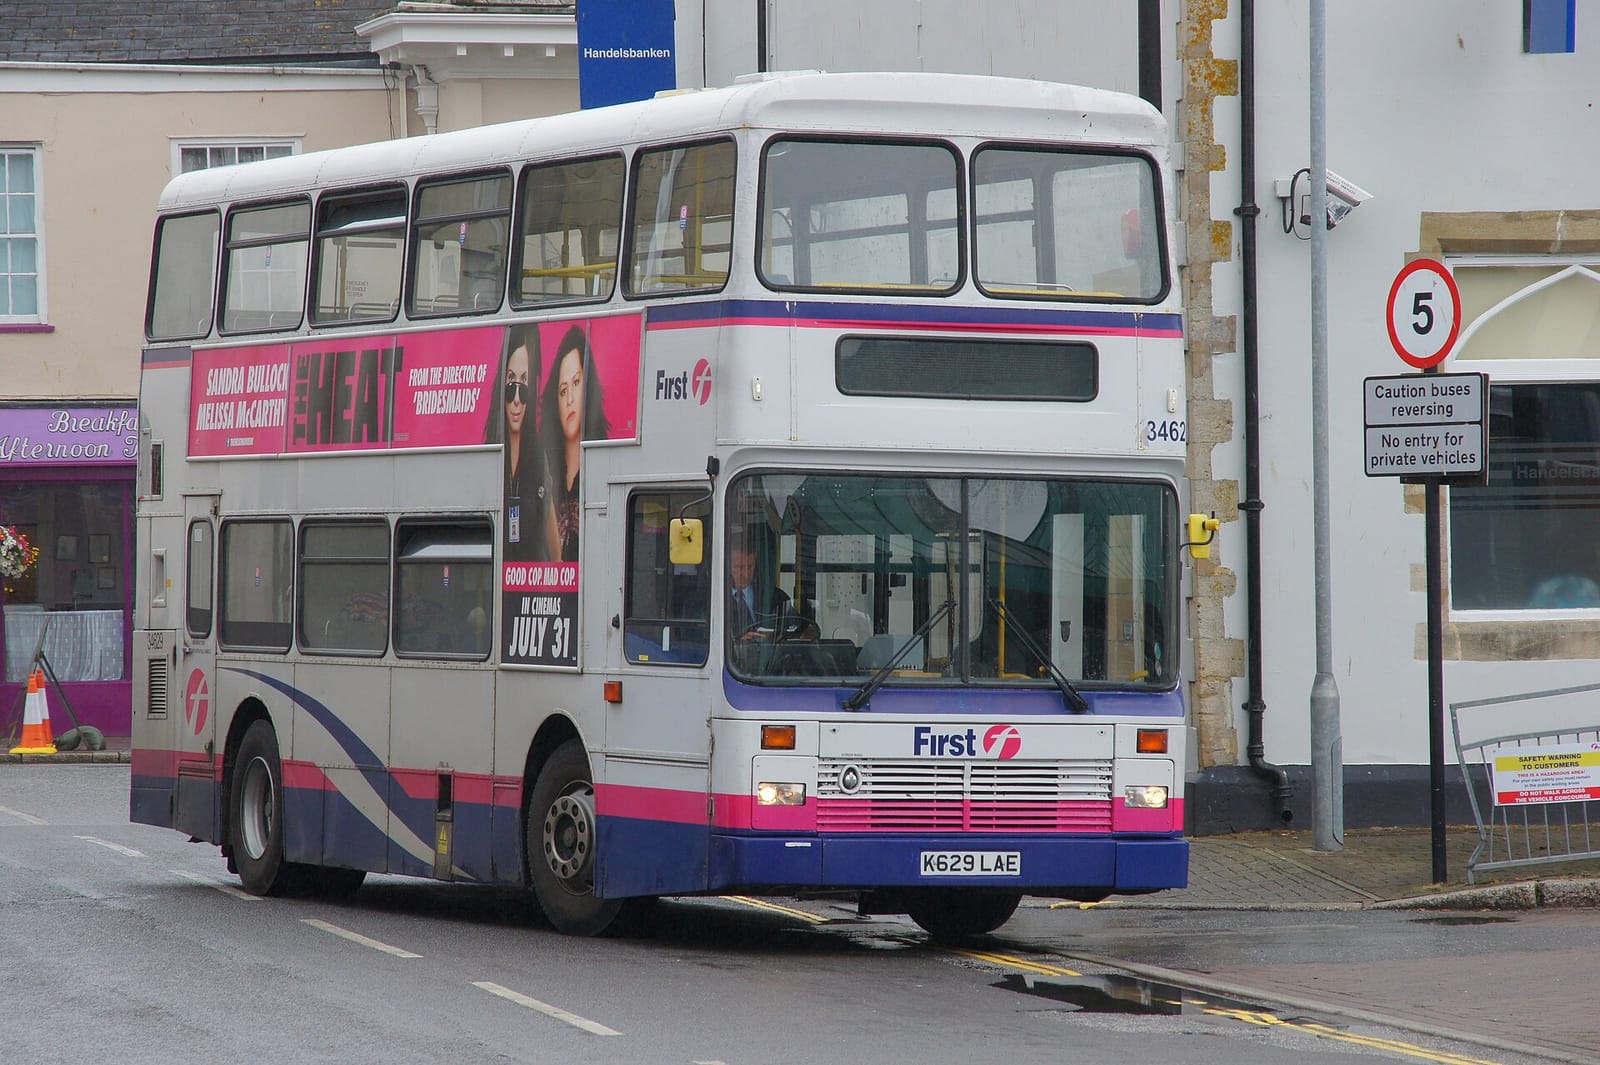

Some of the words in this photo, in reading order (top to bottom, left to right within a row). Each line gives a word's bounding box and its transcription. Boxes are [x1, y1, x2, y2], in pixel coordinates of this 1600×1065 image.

[584, 47, 670, 58] Handelsbanken
[1412, 292, 1434, 335] 5
[206, 366, 245, 396] SANDRA
[246, 362, 290, 393] BULLOCK
[408, 368, 429, 387] FROM
[429, 366, 443, 385] THE
[442, 364, 477, 384] DIRECTOR
[477, 363, 488, 383] OF
[655, 369, 688, 401] First
[1375, 384, 1426, 399] Caution
[1431, 383, 1471, 397] buses
[293, 353, 312, 446] THE
[306, 346, 404, 446] HEAT
[195, 401, 235, 430] MELISSA
[235, 398, 287, 428] McCARTHY
[1392, 402, 1453, 418] reversing
[1381, 434, 1400, 448] No
[1404, 433, 1440, 449] entry
[1444, 432, 1464, 446] for
[1371, 452, 1417, 469] private
[1421, 450, 1476, 465] vehicles
[505, 566, 527, 586] GOOD
[528, 566, 543, 586] COP.
[543, 567, 559, 586] MAD
[560, 567, 576, 586] COP.
[521, 597, 530, 615] IN
[531, 597, 561, 616] CINEMAS
[508, 616, 548, 658] JULY
[551, 617, 571, 659] 31
[913, 726, 977, 757] First
[1518, 755, 1547, 763] SAFETY
[1548, 753, 1582, 761] WARNING
[1534, 761, 1580, 770] CUSTOMERS
[1554, 793, 1592, 801] CONCOURSE
[923, 854, 975, 872] K629
[980, 854, 1018, 872] LAE
